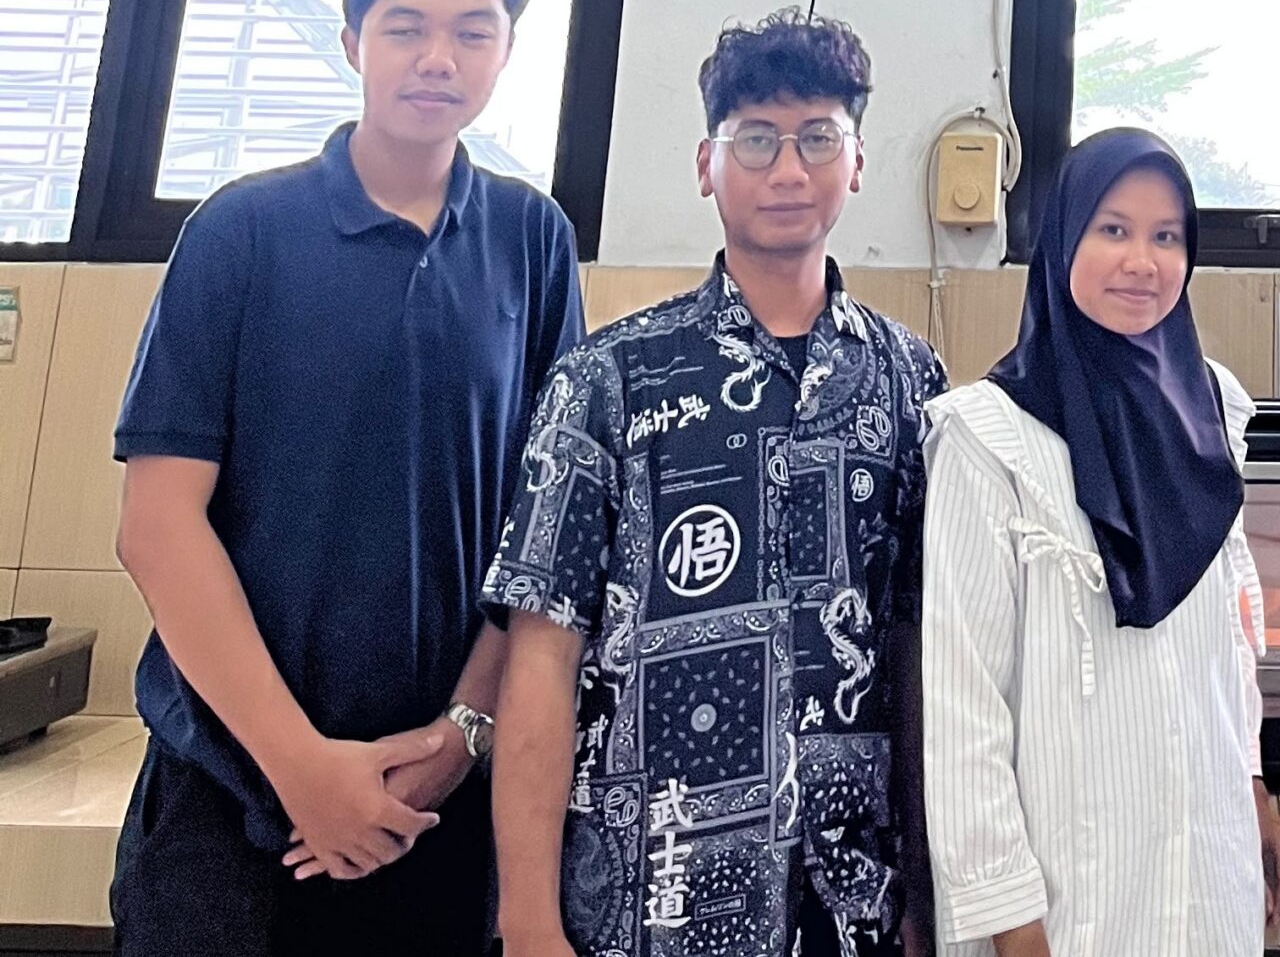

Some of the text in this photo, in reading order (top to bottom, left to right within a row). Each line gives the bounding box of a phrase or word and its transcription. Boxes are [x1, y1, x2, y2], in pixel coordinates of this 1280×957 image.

[667, 516, 732, 589] 悟
[643, 778, 694, 928] 武士道
